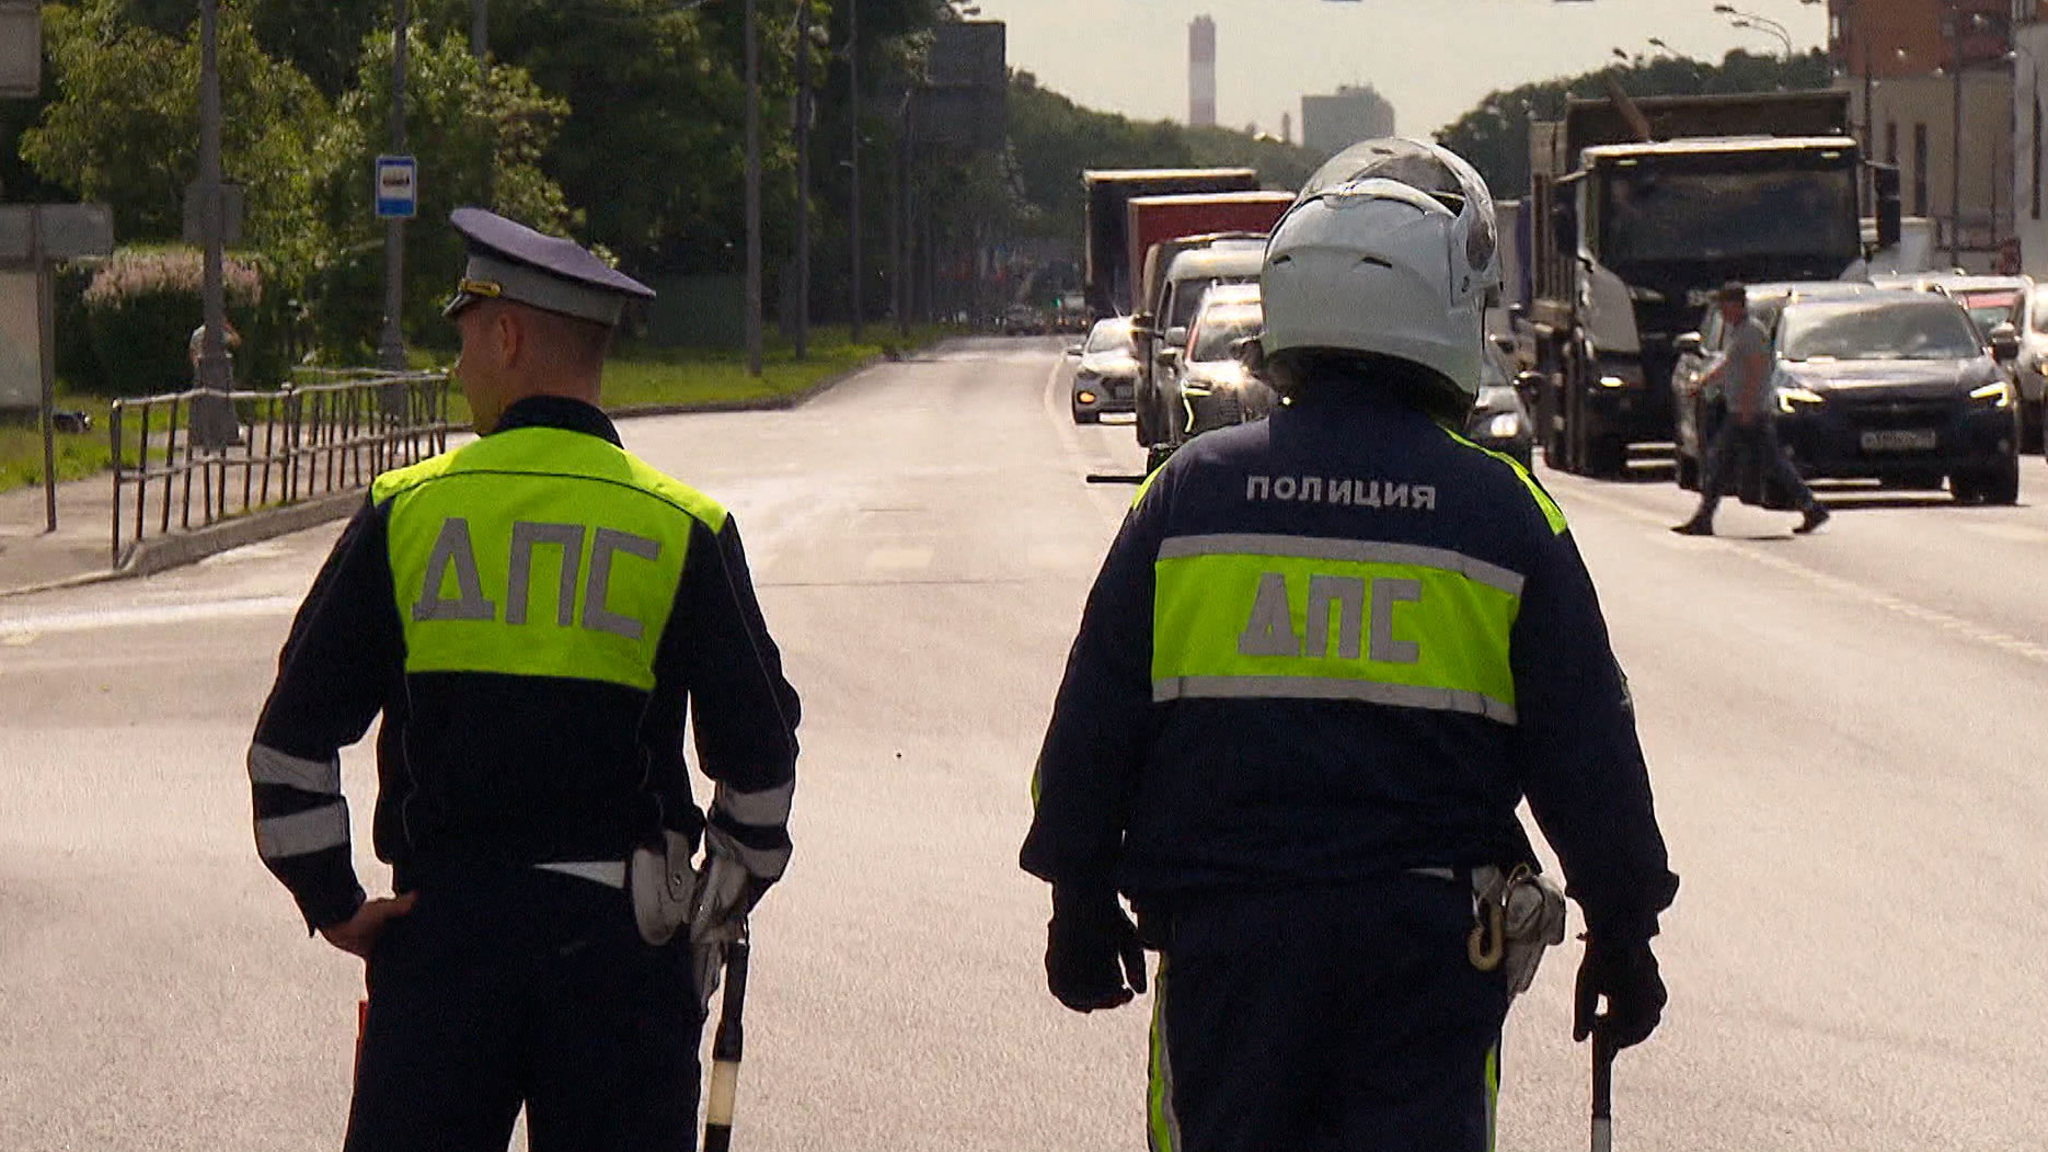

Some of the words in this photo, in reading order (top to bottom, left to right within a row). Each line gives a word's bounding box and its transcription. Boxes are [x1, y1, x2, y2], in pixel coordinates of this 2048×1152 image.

[1246, 475, 1437, 511] ПОЛИЦИЯ
[411, 517, 661, 640] ДПС
[1237, 571, 1422, 664] ДПС
